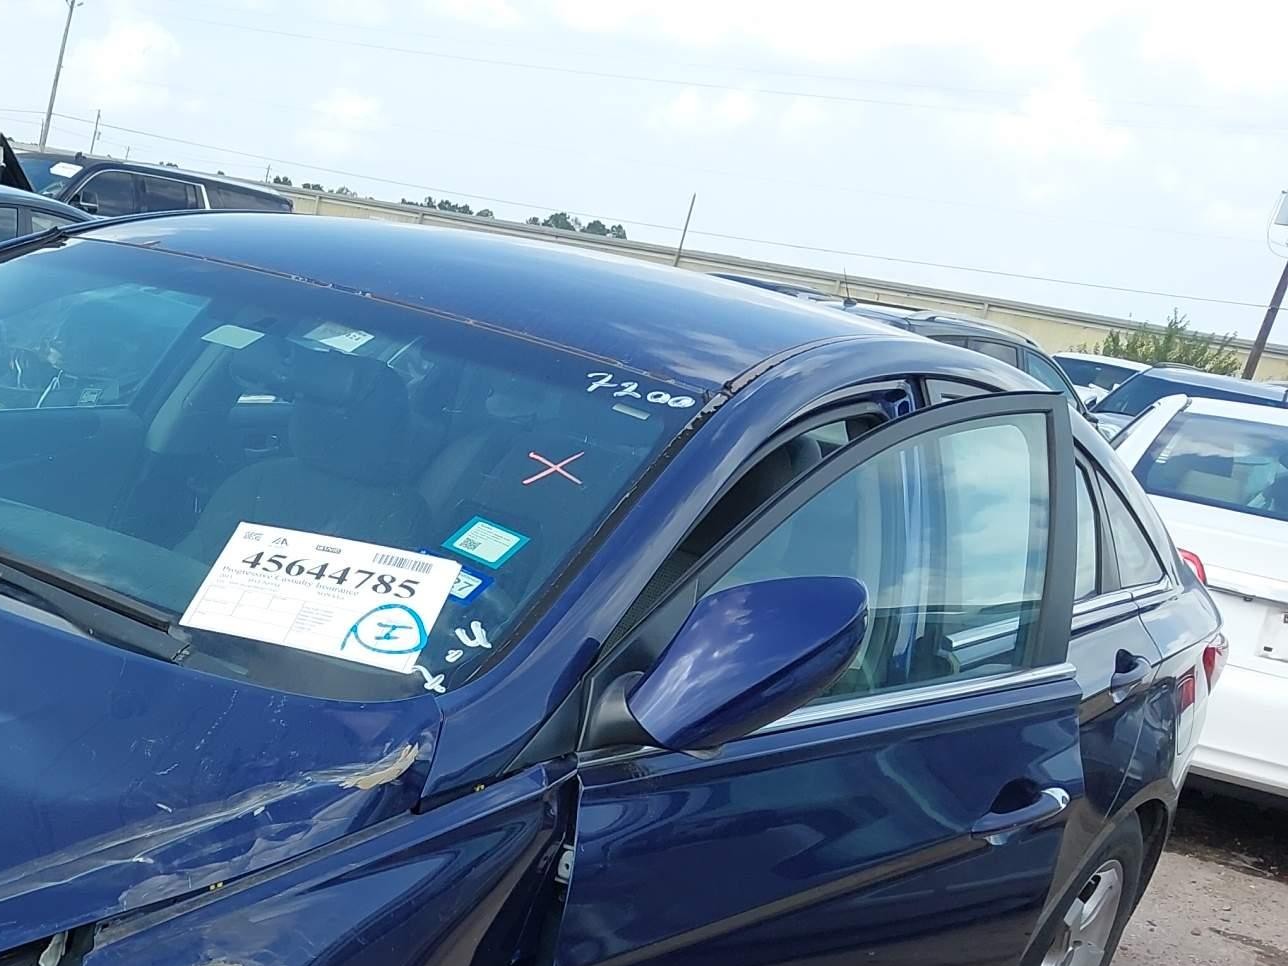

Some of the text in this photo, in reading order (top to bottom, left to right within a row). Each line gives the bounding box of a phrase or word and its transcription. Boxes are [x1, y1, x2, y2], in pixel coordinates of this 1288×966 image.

[586, 372, 696, 408] 7200
[222, 565, 273, 580] Progressive
[315, 582, 359, 596] Insurance
[241, 551, 420, 599] 45644785
